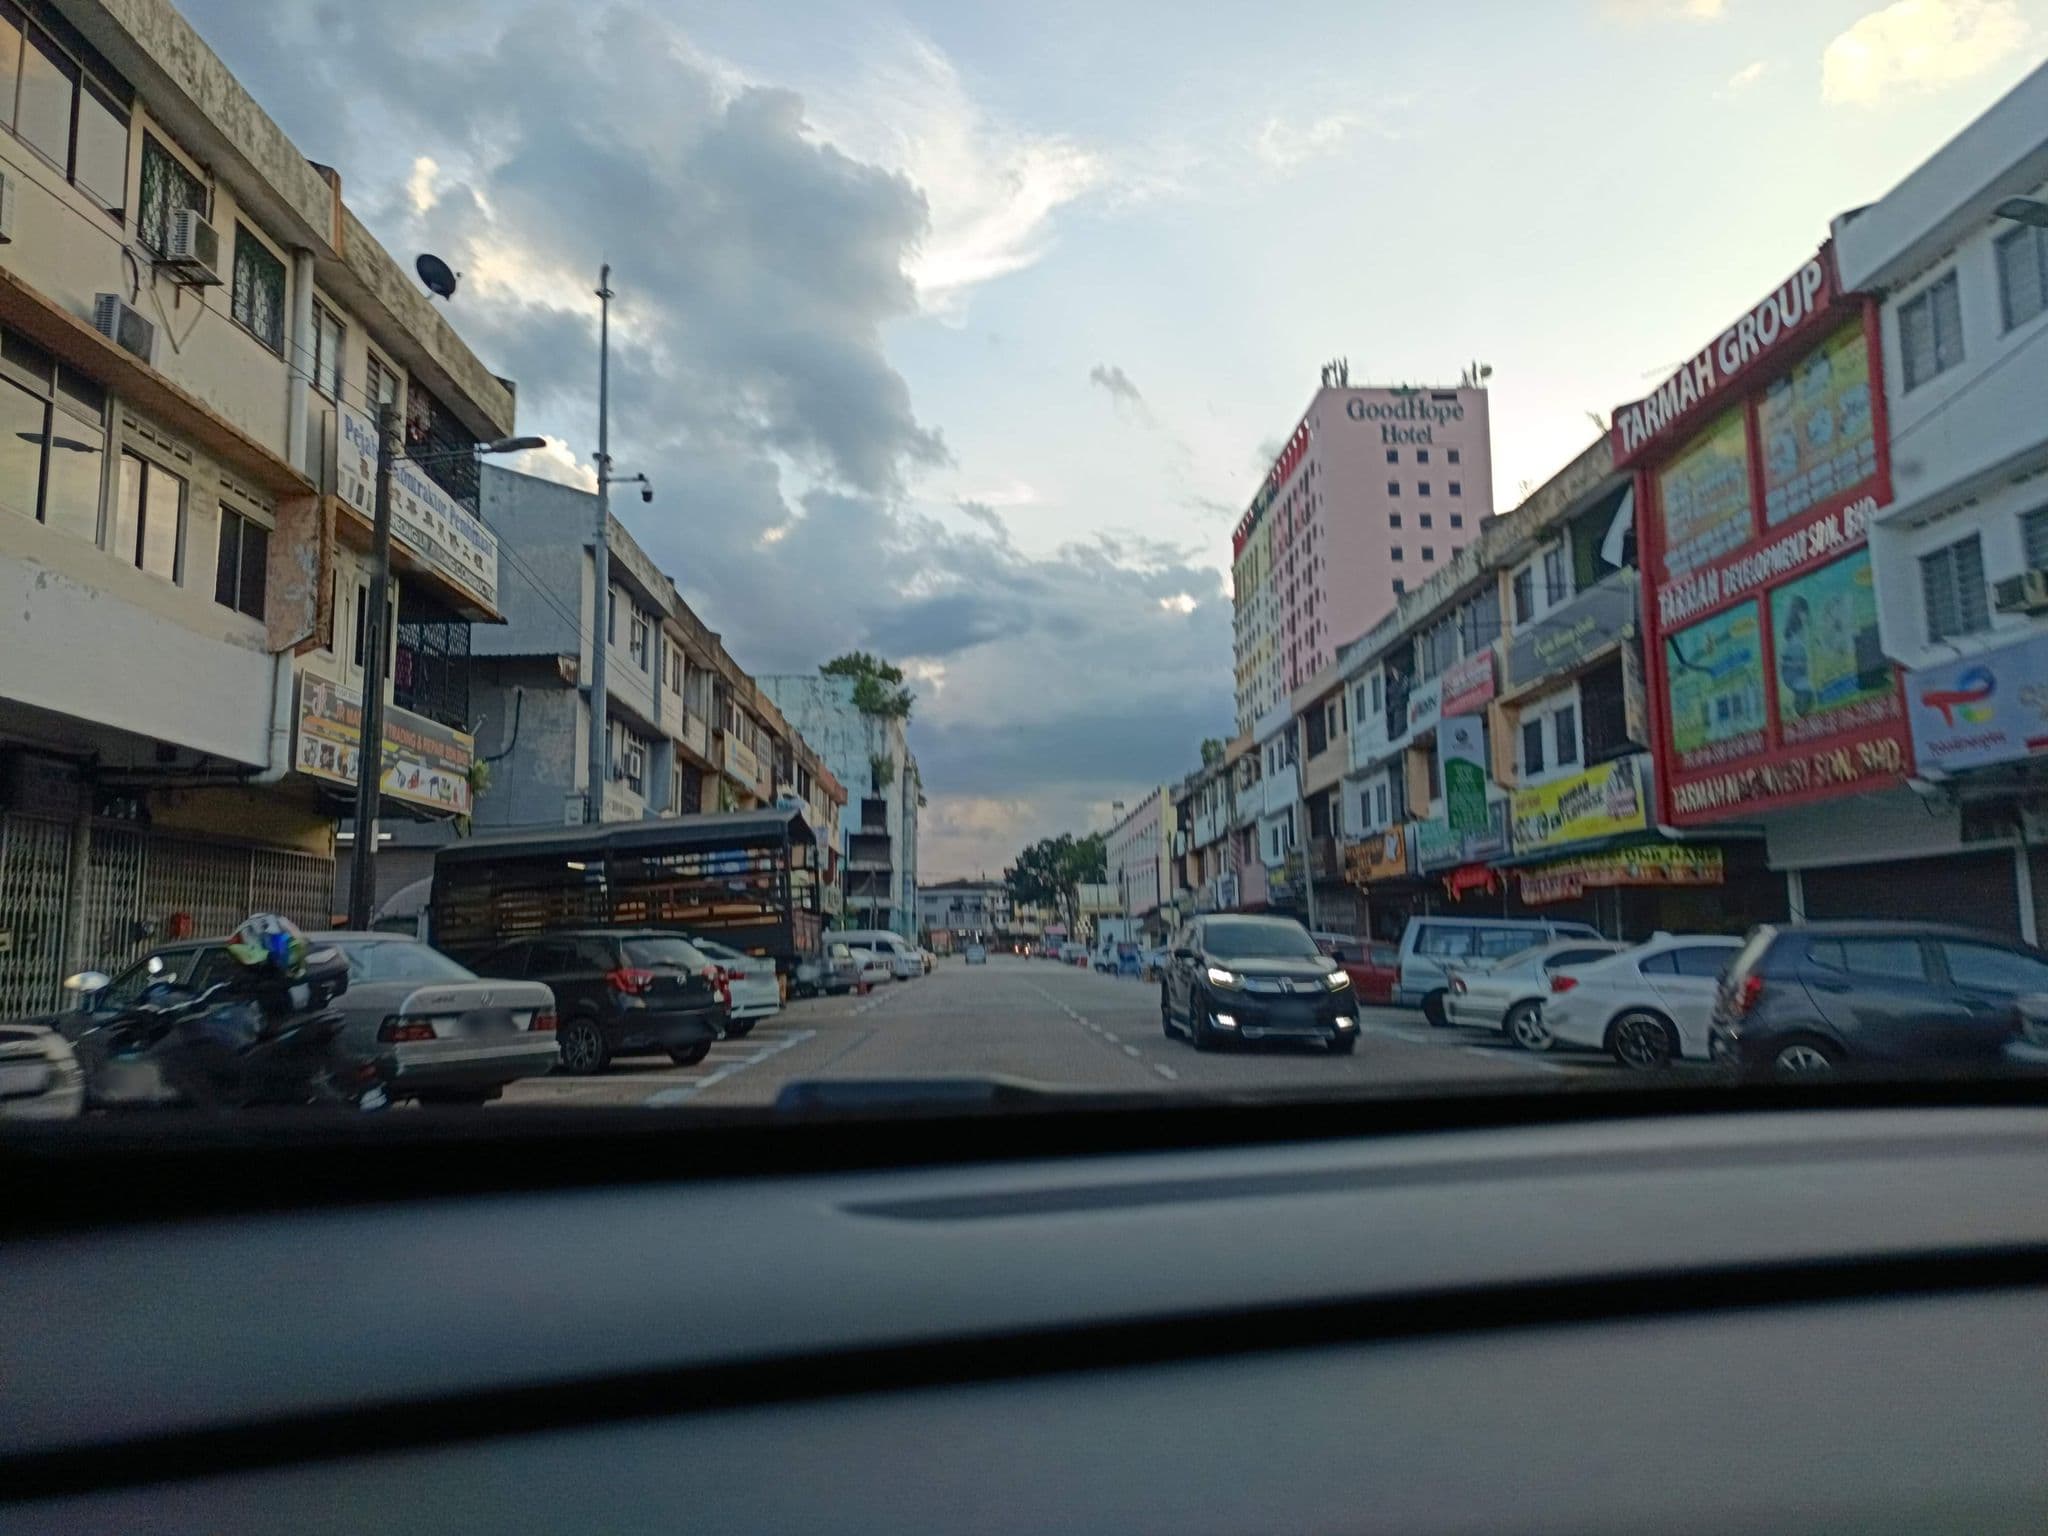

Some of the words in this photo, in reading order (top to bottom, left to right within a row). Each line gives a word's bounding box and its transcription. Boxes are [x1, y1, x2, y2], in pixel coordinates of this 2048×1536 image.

[1618, 347, 1716, 454] TARMAH
[1718, 261, 1822, 376] GROUP
[1381, 423, 1433, 445] Hotel
